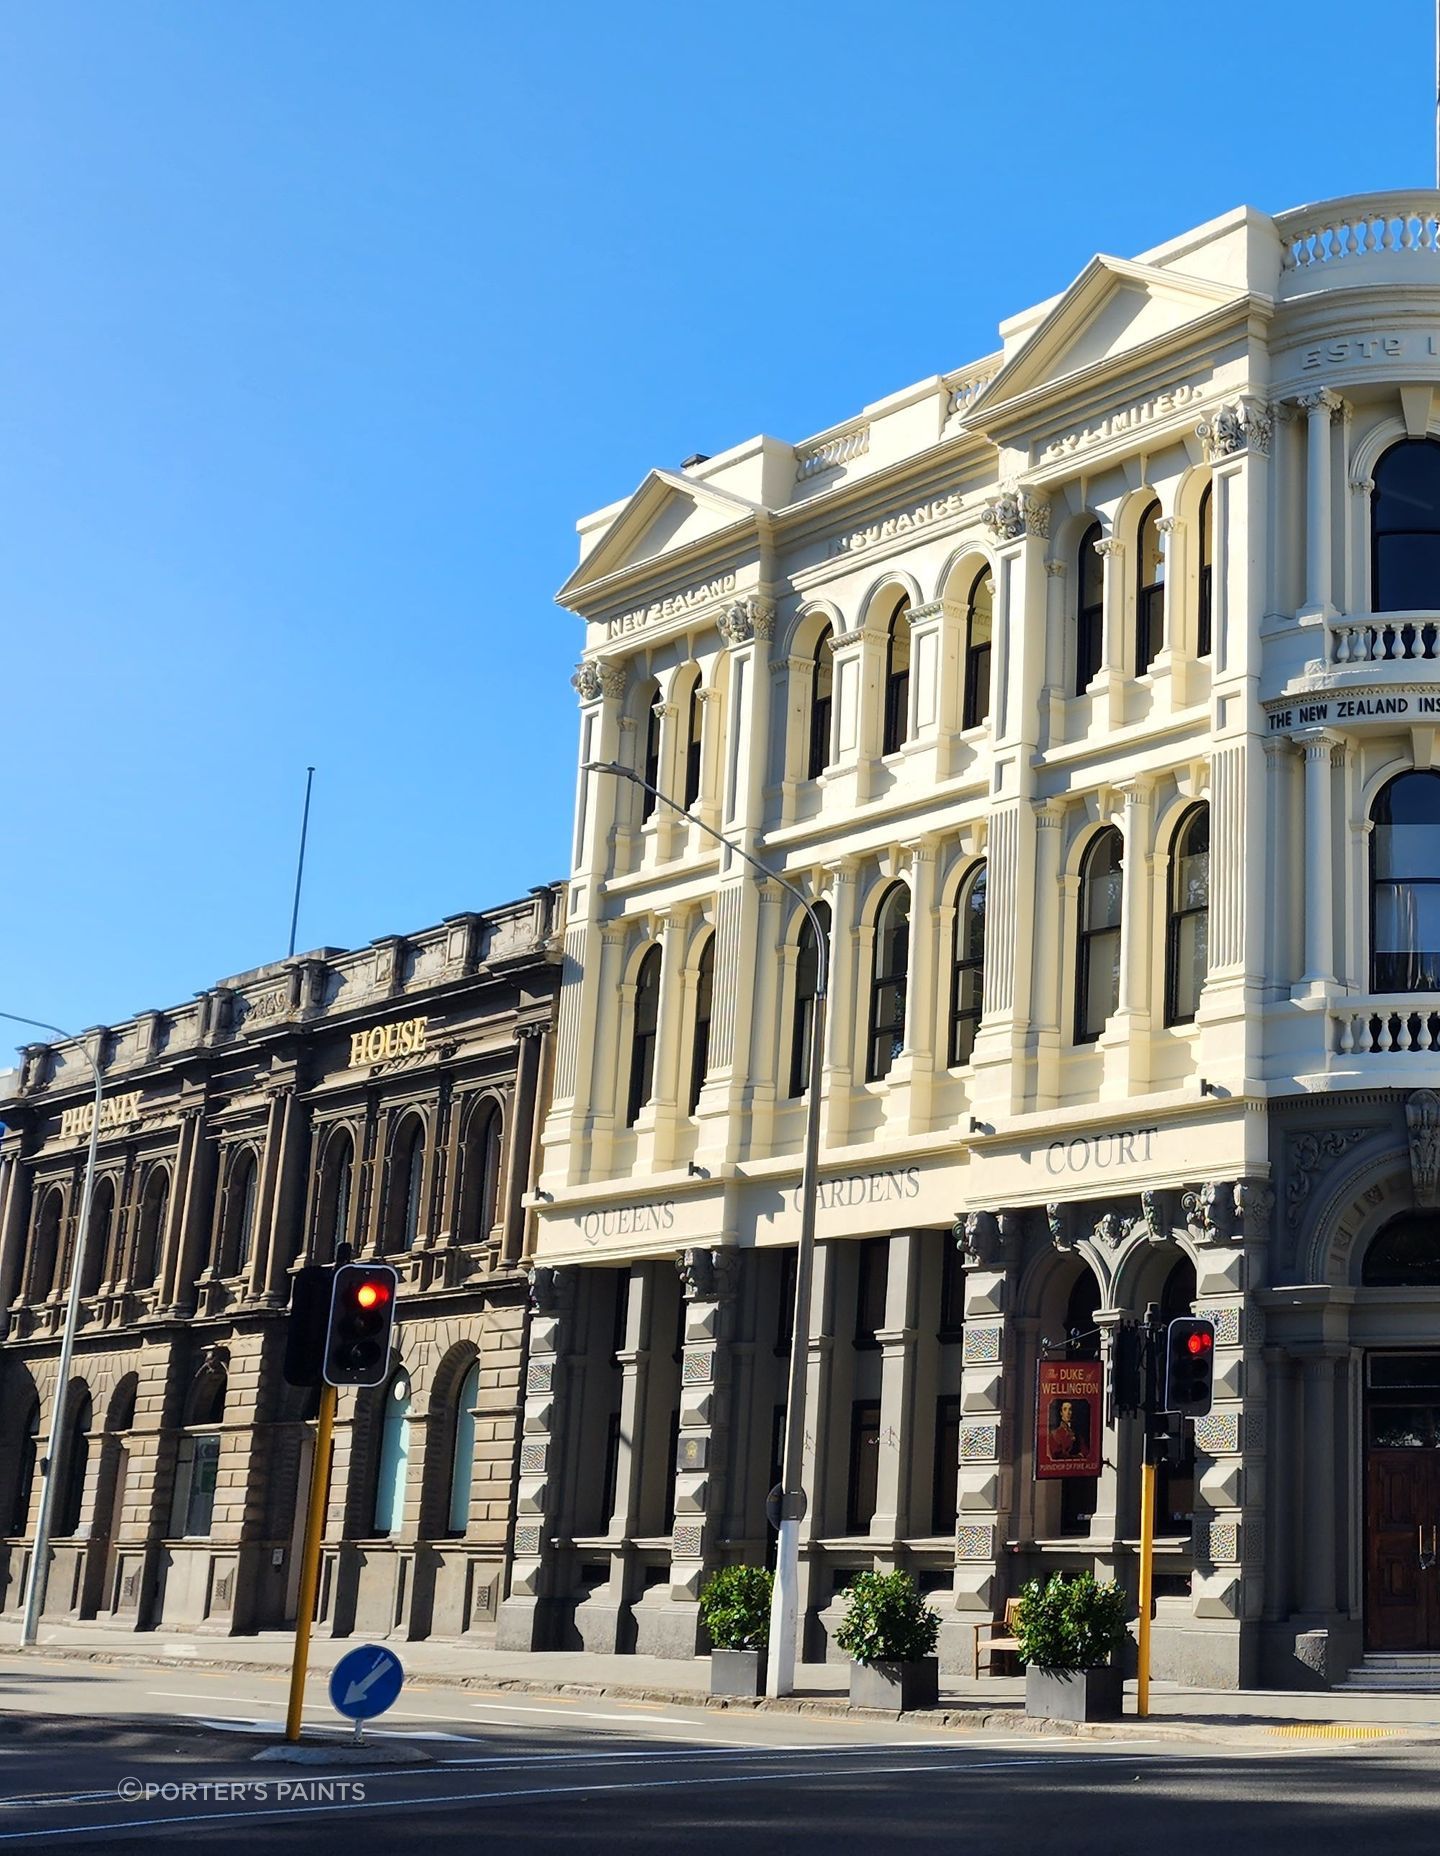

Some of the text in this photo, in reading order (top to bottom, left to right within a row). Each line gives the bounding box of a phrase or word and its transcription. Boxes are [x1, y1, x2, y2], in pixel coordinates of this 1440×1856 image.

[607, 574, 736, 639] NEW ZEALAND
[1268, 710, 1292, 730] THE
[1300, 702, 1328, 723] NEW
[1337, 698, 1409, 717] ZEALAND
[348, 1016, 429, 1068] HOUSE
[1046, 1127, 1158, 1175] COURT
[585, 1201, 675, 1246] QUEENS
[1042, 1383, 1099, 1394] WELLINGTON
[1060, 1369, 1084, 1380] DUKE
